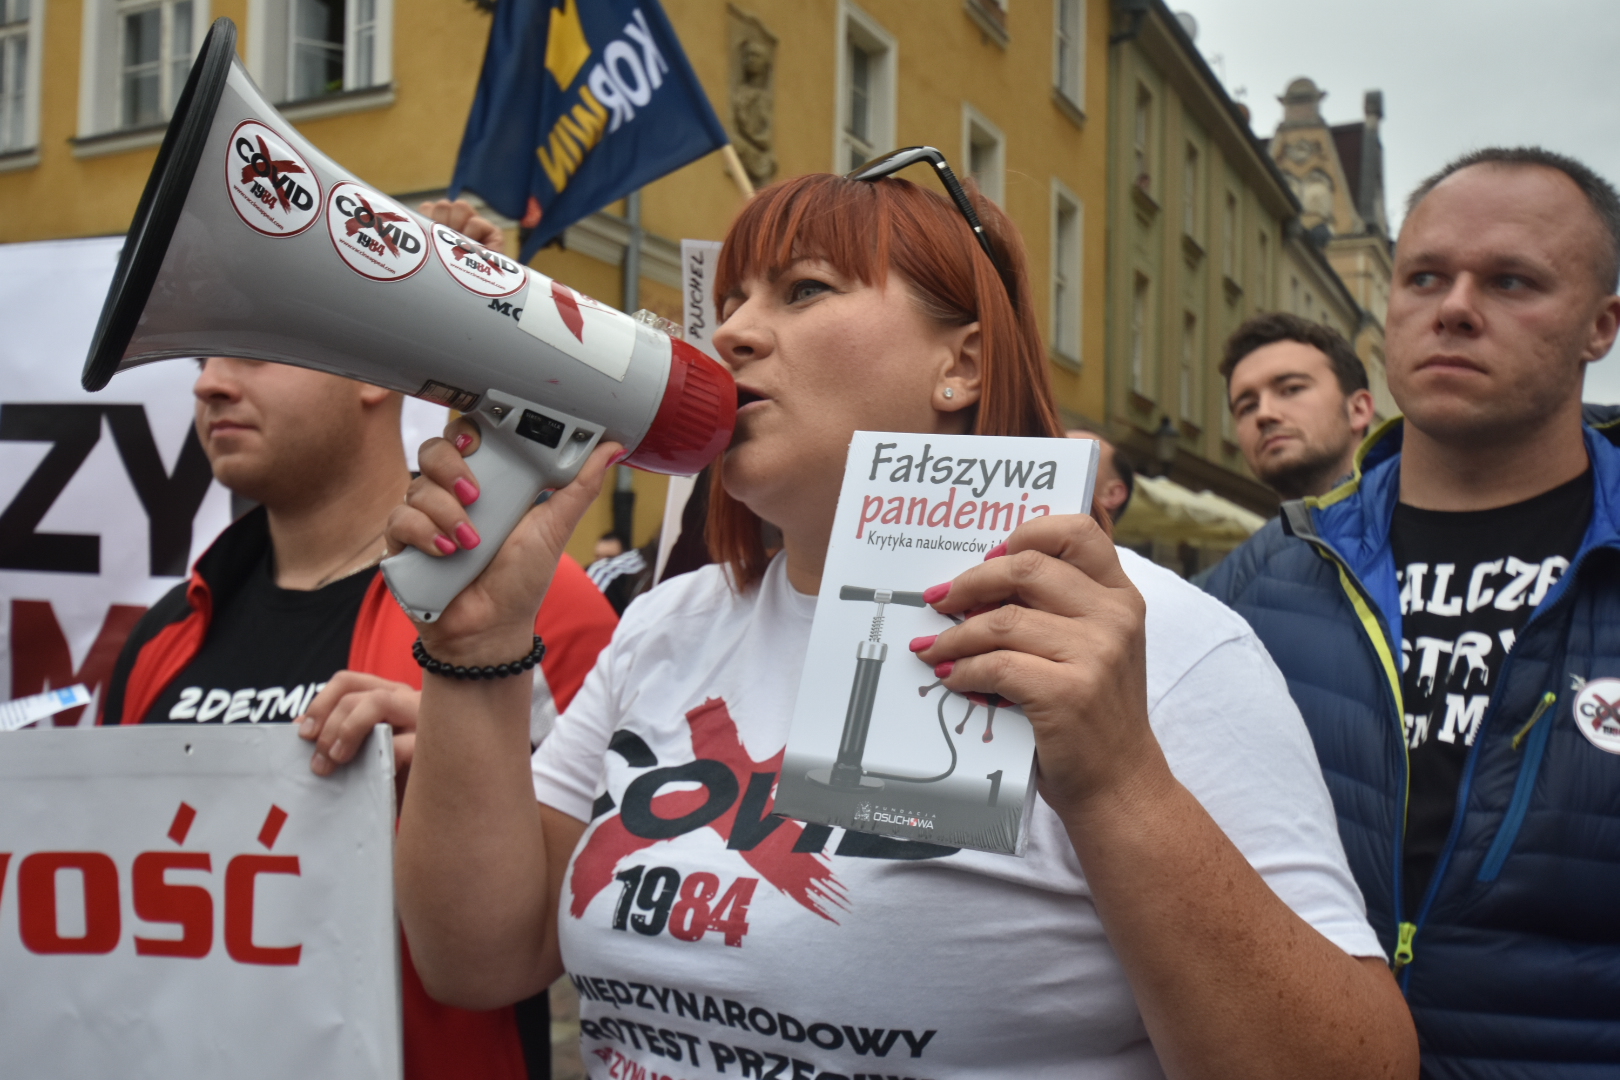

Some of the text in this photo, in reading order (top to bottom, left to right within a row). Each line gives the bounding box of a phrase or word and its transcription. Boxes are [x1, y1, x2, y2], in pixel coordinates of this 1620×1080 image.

[236, 137, 313, 211] COVID
[250, 180, 278, 210] 1984
[335, 195, 421, 254] COVID
[356, 231, 386, 256] 1984
[437, 230, 519, 274] COVID
[464, 256, 492, 276] 1984
[868, 442, 1058, 498] Fałszywa
[867, 530, 912, 551] Krytyka
[915, 535, 987, 553] naukowców
[985, 770, 1003, 808] 1
[611, 863, 760, 949] 1984
[568, 971, 938, 1059] MIĘDZYNARODOWY
[579, 1016, 702, 1068] ROTEST
